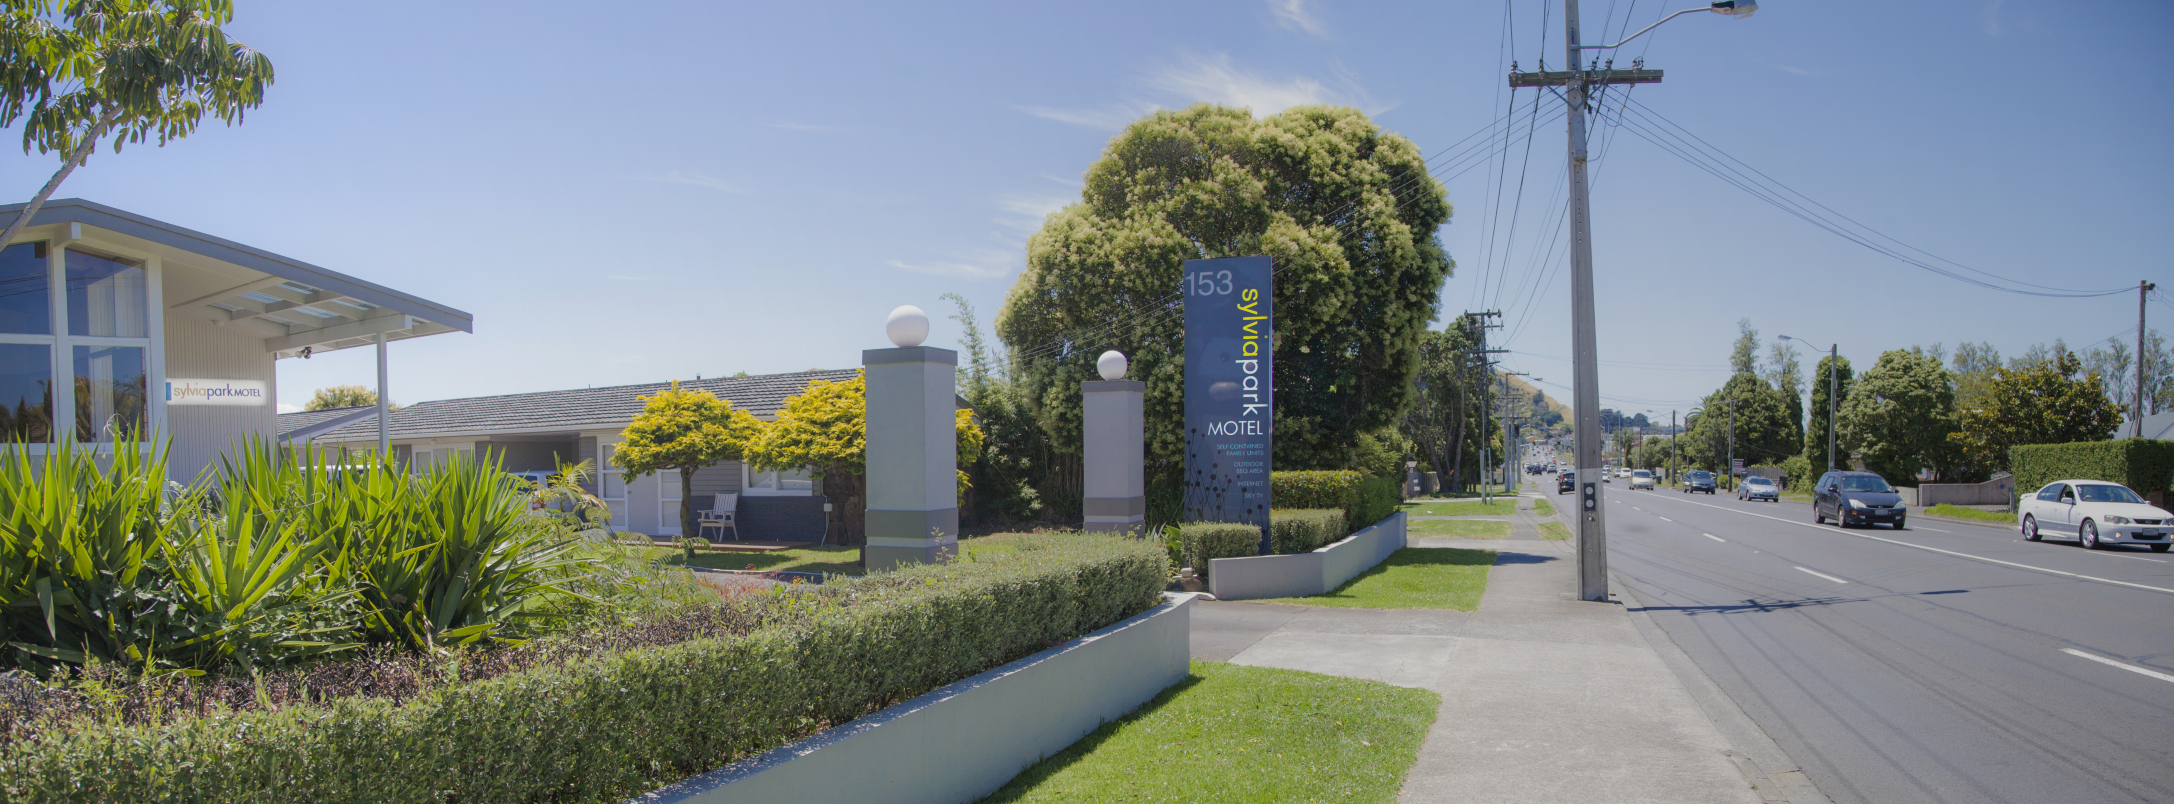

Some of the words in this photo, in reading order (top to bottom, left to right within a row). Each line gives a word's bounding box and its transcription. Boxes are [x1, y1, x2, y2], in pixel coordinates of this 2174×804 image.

[1185, 269, 1233, 296] 153
[234, 388, 261, 397] MOTEL
[1207, 420, 1264, 435] MOTEL
